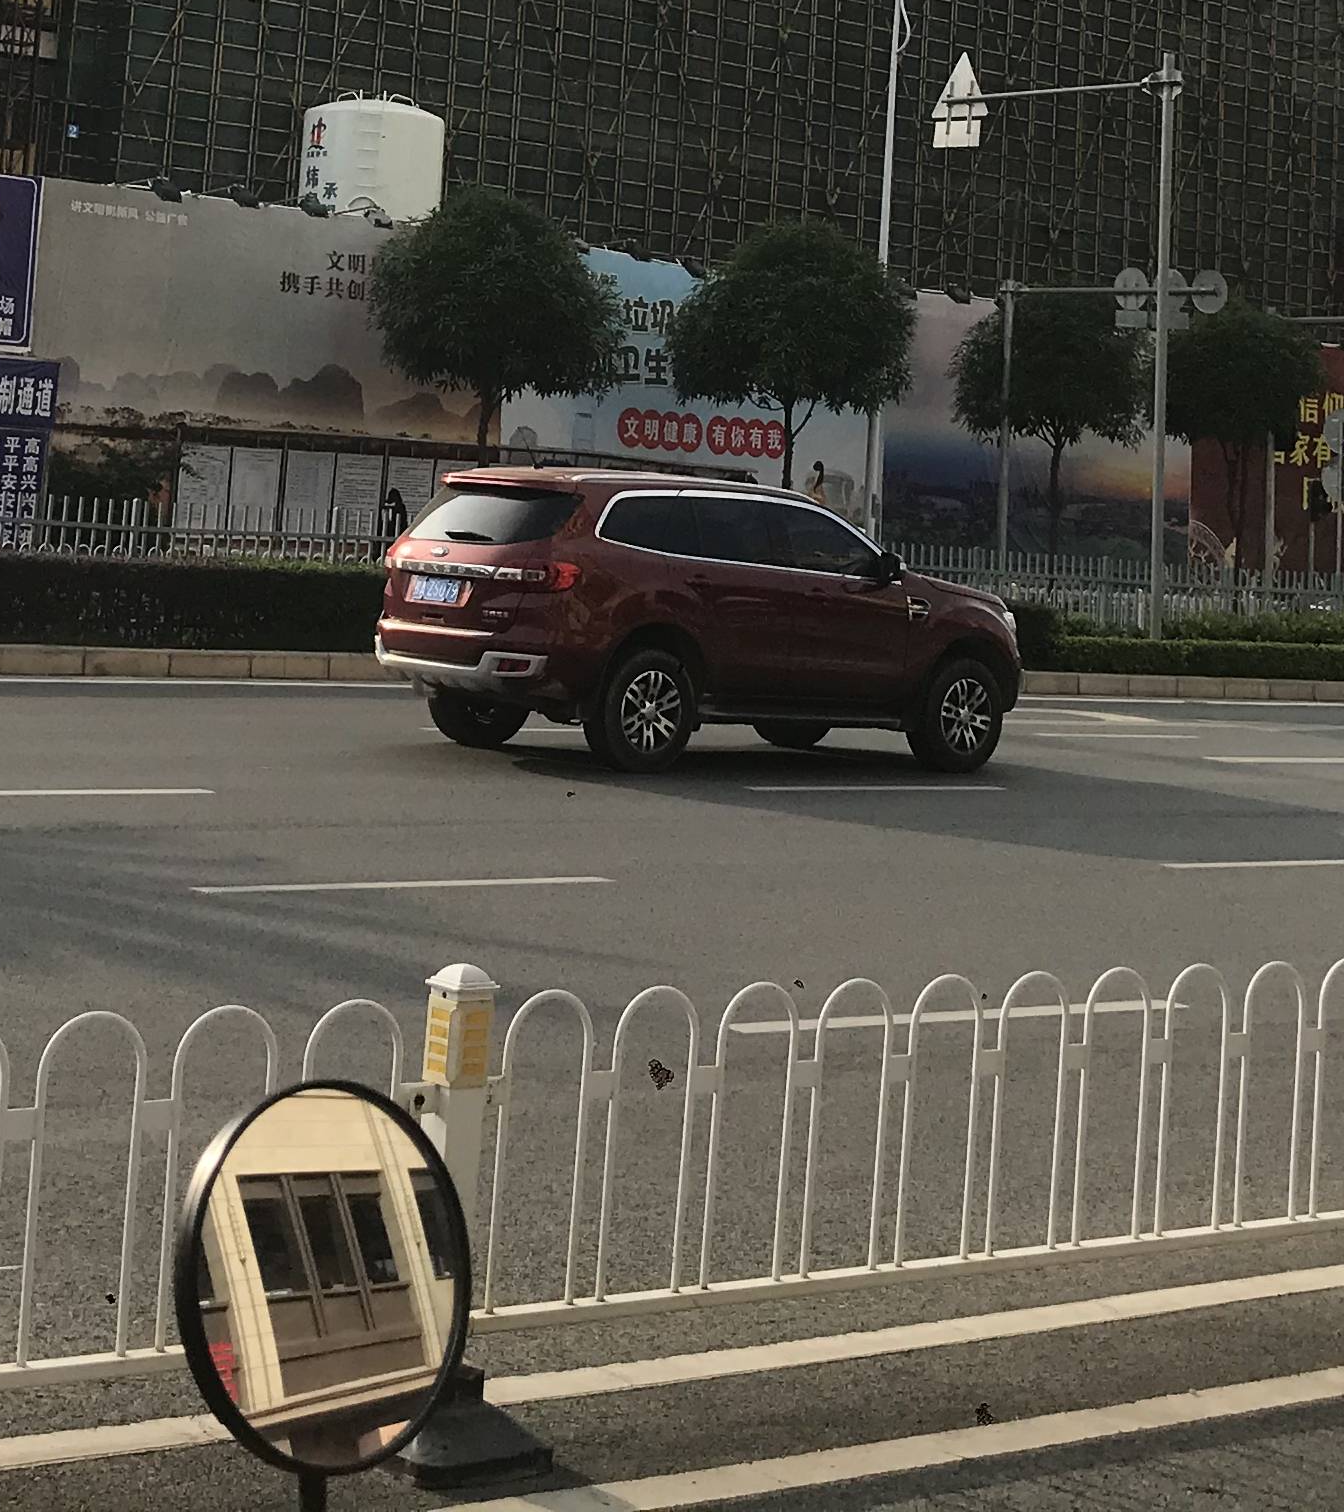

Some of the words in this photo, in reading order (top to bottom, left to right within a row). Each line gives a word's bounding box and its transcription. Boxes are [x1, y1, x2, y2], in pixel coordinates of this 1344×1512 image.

[68, 125, 77, 137] 2
[325, 250, 377, 276] 文明
[279, 271, 377, 302] 携手共创
[624, 417, 698, 444] 文明健康
[712, 424, 783, 451] 有你有我
